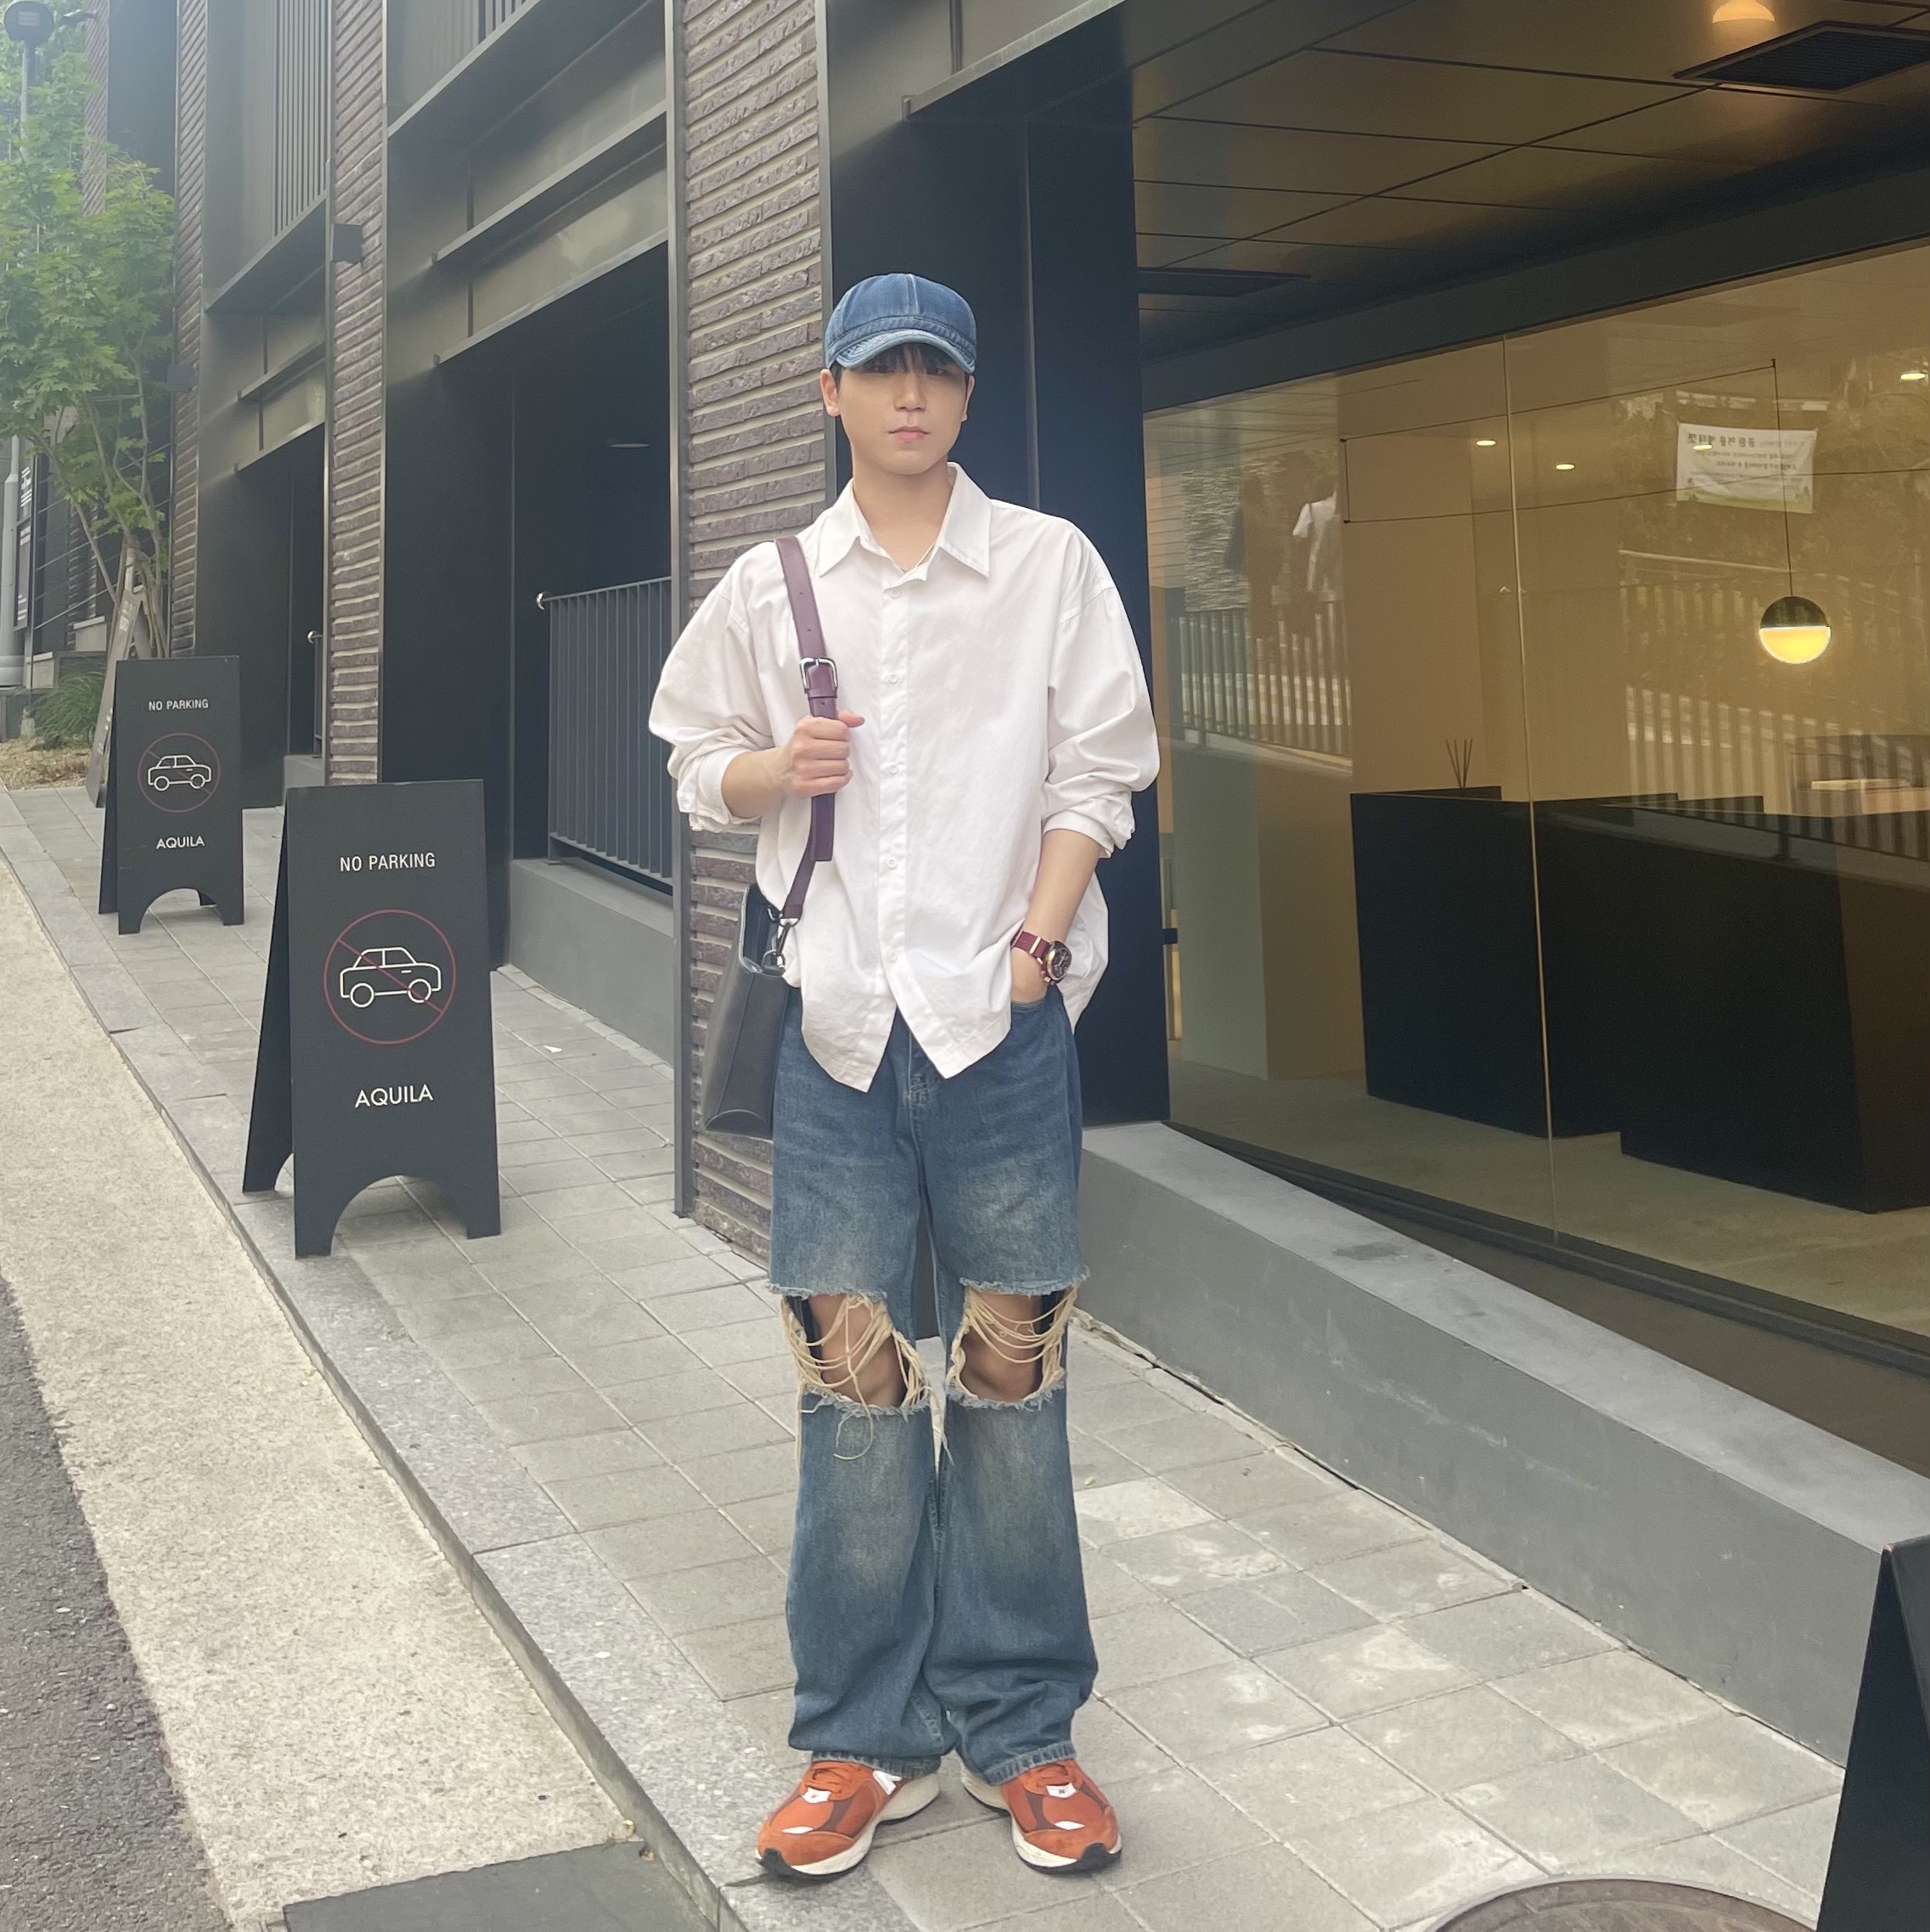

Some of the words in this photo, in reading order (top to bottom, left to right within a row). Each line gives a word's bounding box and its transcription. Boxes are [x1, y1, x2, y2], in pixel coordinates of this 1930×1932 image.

[149, 701, 163, 711] NO
[166, 698, 209, 710] PARKING
[155, 835, 205, 849] AQUILA
[340, 856, 362, 872] NO
[369, 852, 436, 870] PARKING
[354, 1084, 434, 1108] AQUILA
